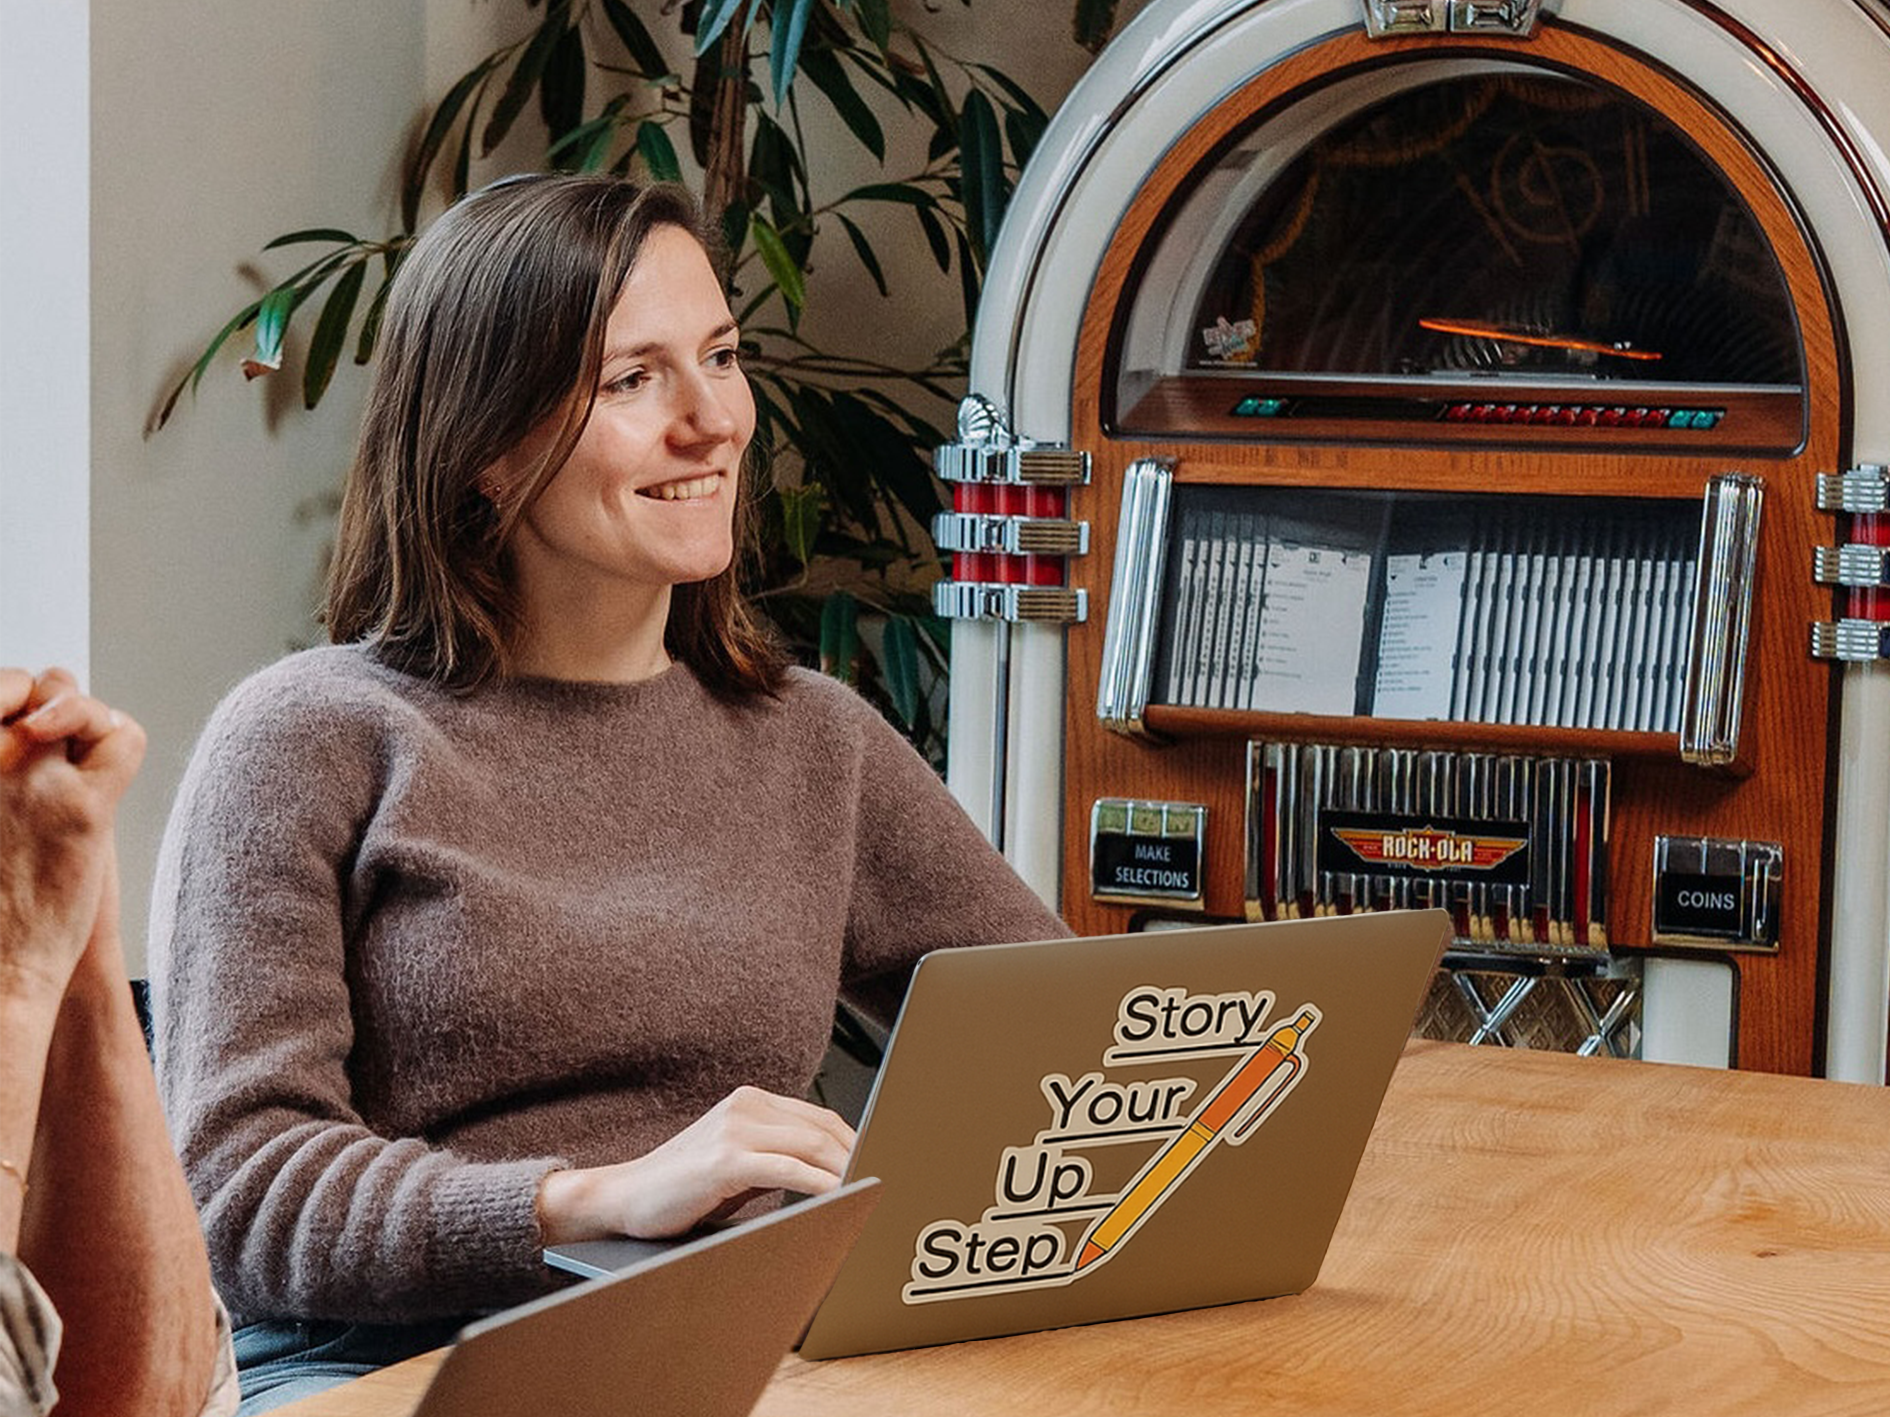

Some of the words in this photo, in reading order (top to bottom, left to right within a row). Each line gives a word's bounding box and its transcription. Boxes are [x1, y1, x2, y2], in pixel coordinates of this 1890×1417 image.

[1115, 866, 1190, 888] SELECTIONS
[1134, 844, 1171, 862] MAKE
[1677, 890, 1735, 910] COINS
[1120, 993, 1268, 1044] Story
[1049, 1079, 1187, 1130] Your
[1002, 1151, 1087, 1209] Up
[917, 1228, 1060, 1276] Step
